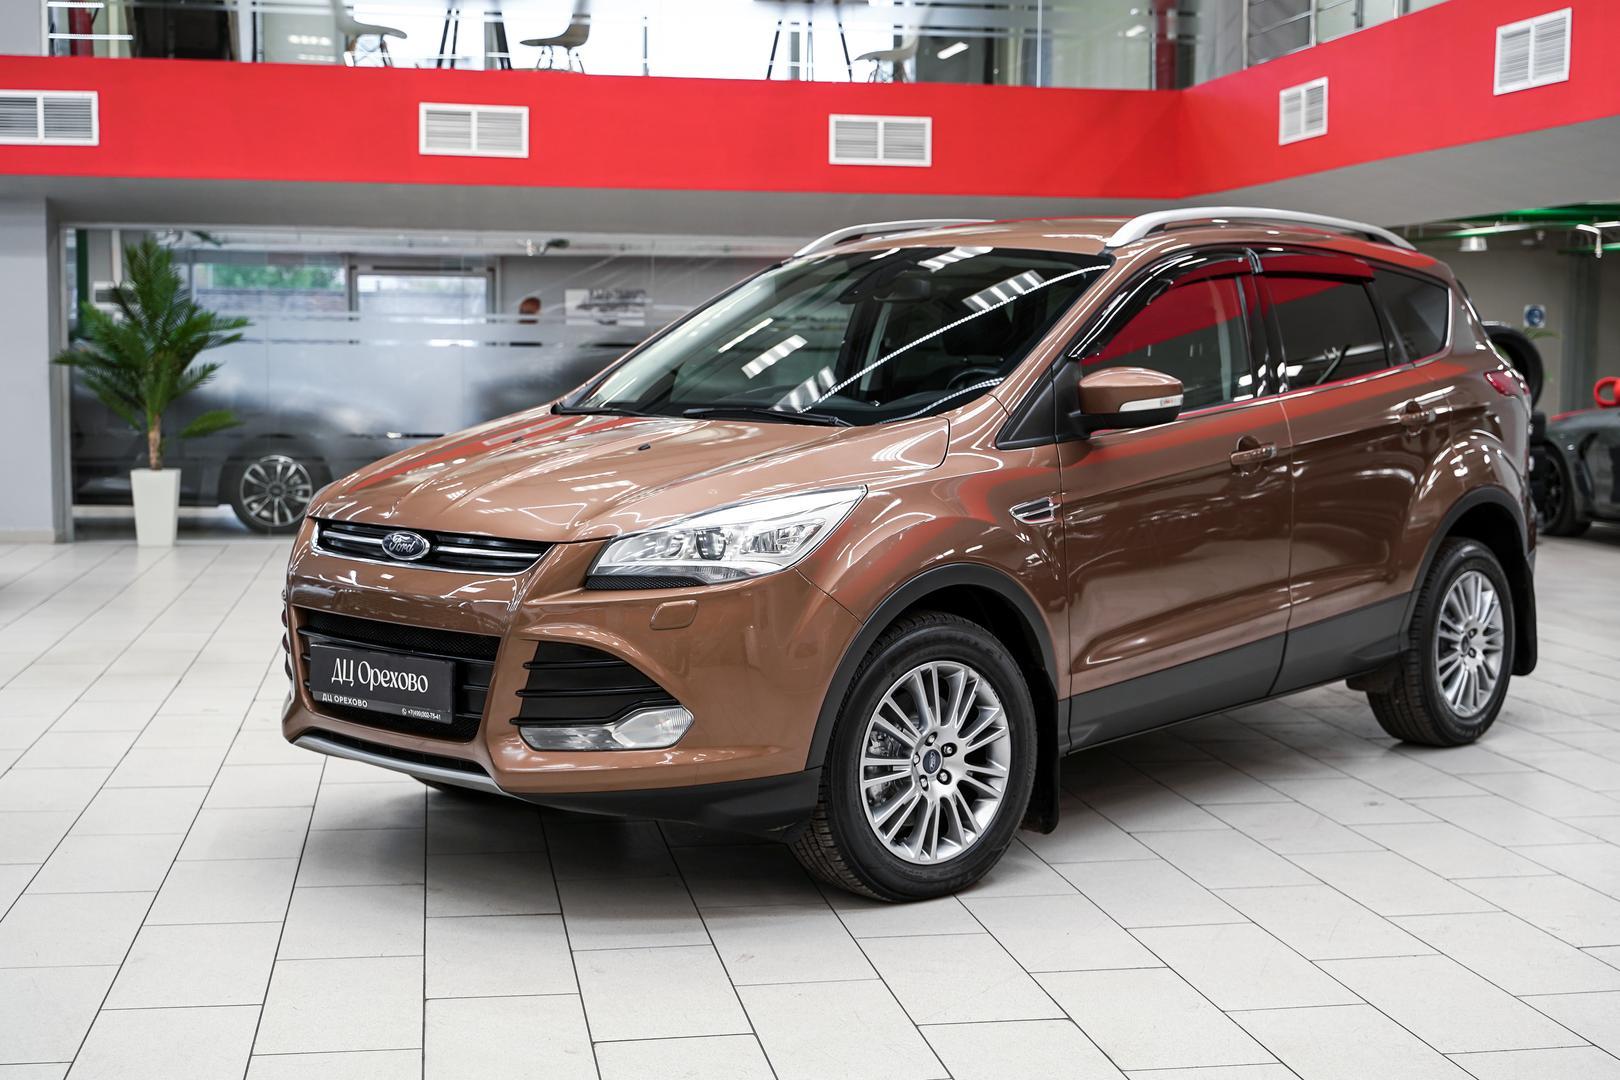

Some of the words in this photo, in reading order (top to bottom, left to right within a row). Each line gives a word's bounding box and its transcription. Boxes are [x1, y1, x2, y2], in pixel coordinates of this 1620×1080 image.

[389, 534, 416, 553] Ford
[331, 657, 354, 687] ДЦ
[357, 660, 429, 693] Орехово
[322, 693, 333, 702] ДЦ
[334, 696, 368, 708] ОРЕХОВО
